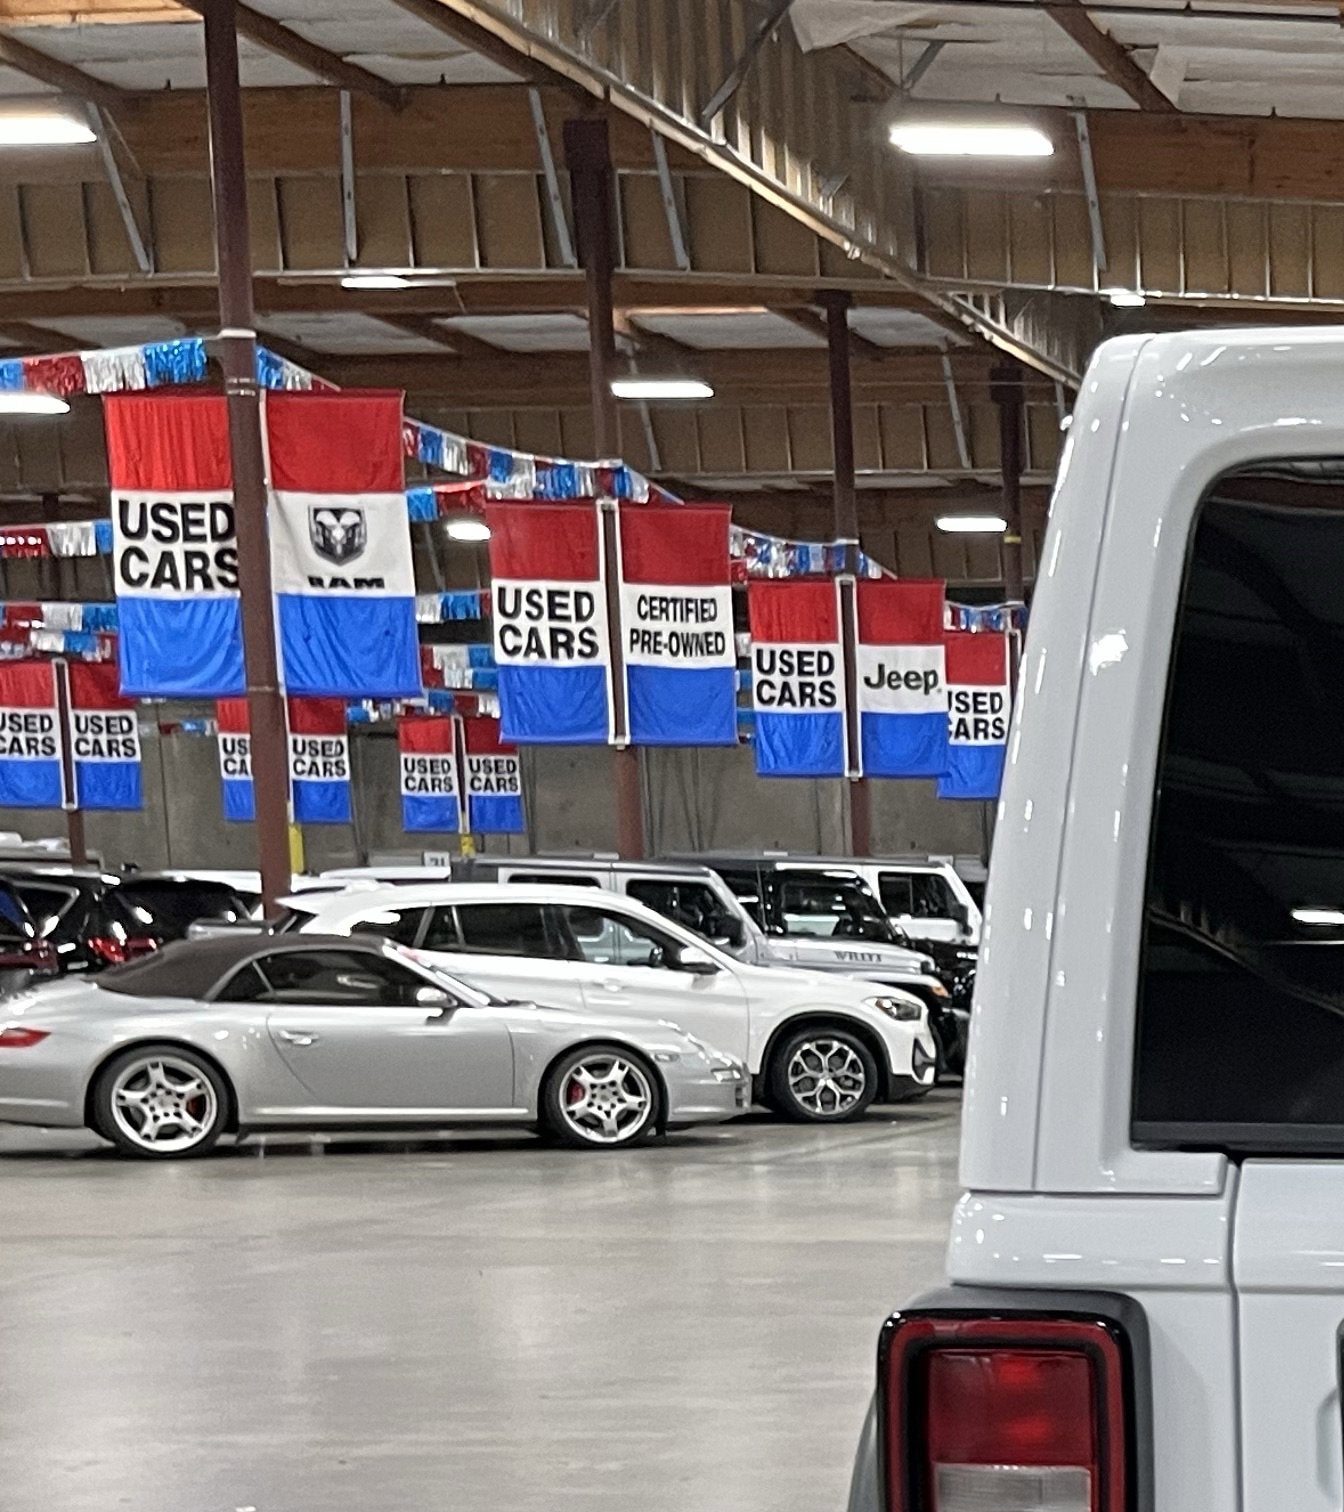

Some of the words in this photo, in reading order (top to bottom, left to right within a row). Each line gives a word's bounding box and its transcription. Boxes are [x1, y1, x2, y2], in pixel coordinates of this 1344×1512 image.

[119, 500, 235, 543] USED
[120, 546, 239, 591] CARS
[308, 576, 385, 589] RAM
[498, 587, 595, 623] USED
[637, 594, 718, 624] CERTIFIED
[499, 624, 600, 660] CARS
[629, 628, 726, 658] PRE-OWNED
[756, 648, 835, 677] USED
[864, 663, 939, 696] Jeep
[756, 680, 837, 708] CARS
[75, 714, 134, 735] USED
[949, 717, 1005, 740] ARS
[75, 737, 137, 757] CARS
[222, 737, 248, 756] US
[292, 738, 345, 758] USED
[223, 757, 249, 776] CA
[292, 758, 347, 777] CARS
[404, 758, 452, 774] USED
[468, 758, 517, 775] USED
[404, 776, 454, 793] CARS
[469, 776, 519, 793] CARS
